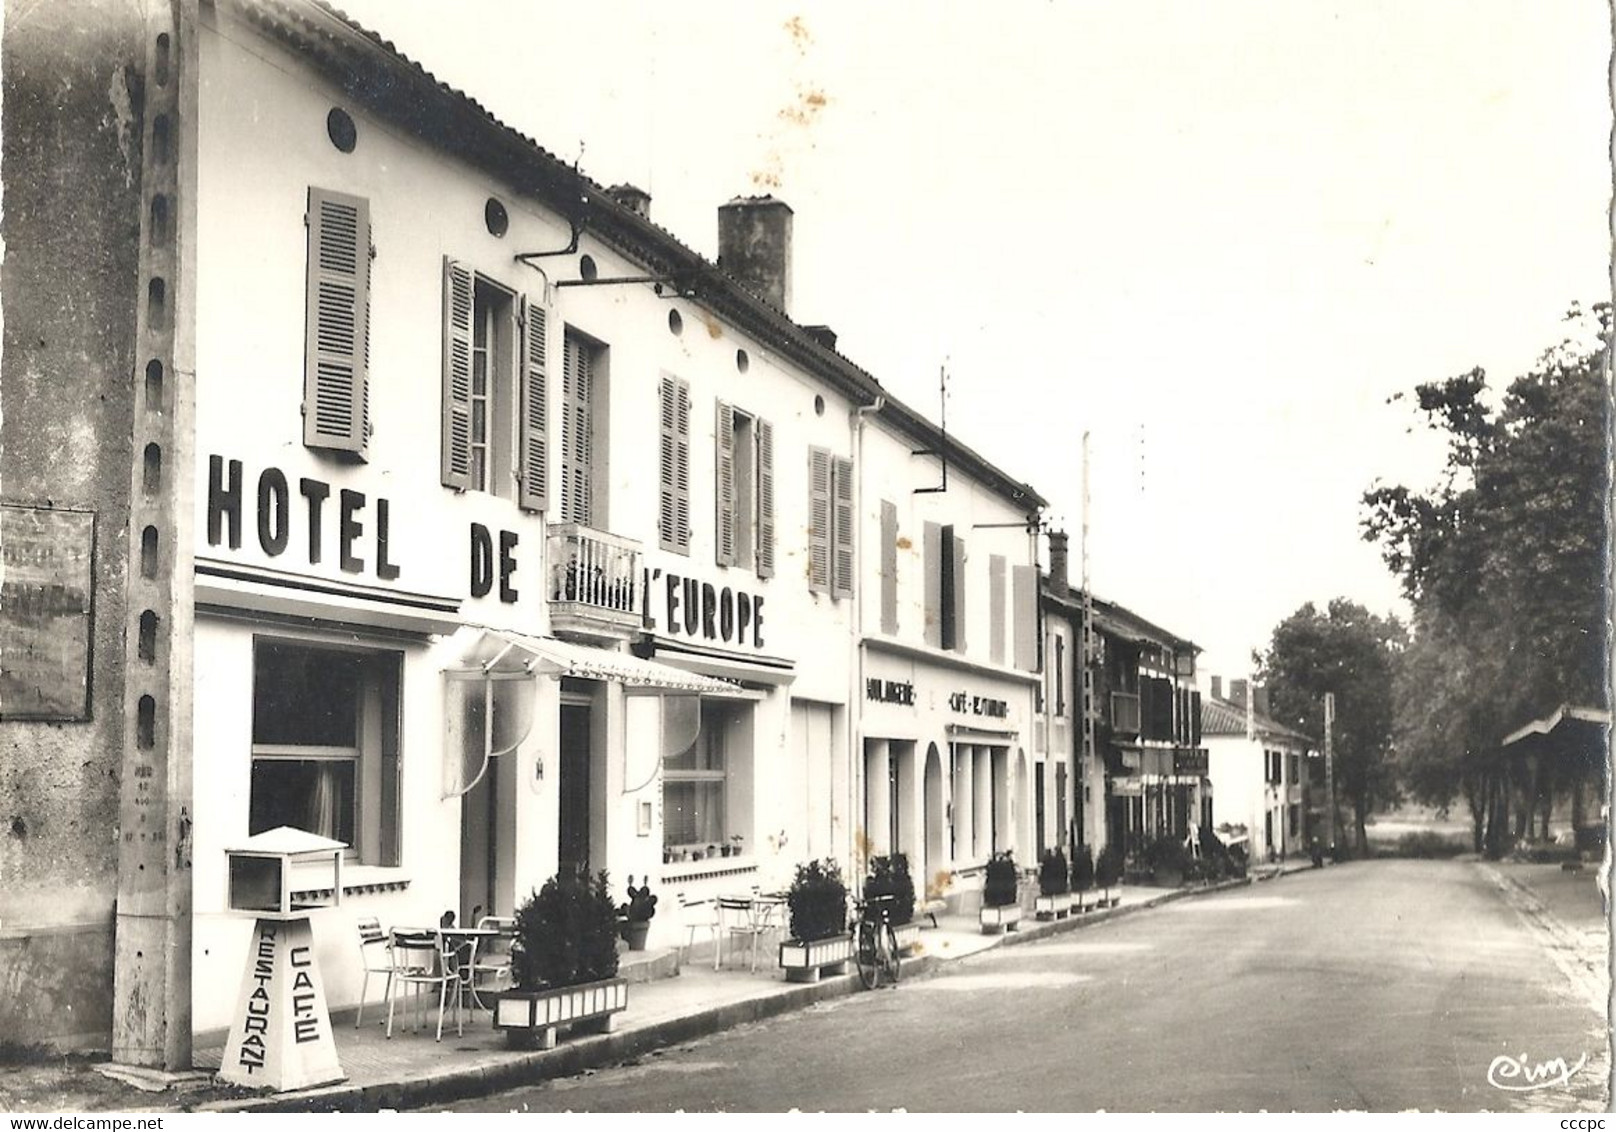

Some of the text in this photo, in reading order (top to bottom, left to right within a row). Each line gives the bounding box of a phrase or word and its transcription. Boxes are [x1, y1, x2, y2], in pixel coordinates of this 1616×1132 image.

[208, 454, 764, 649] HOTEL DE L'EUROPE
[239, 929, 277, 1075] RESTAURANT
[290, 946, 320, 1044] CAFÉ
